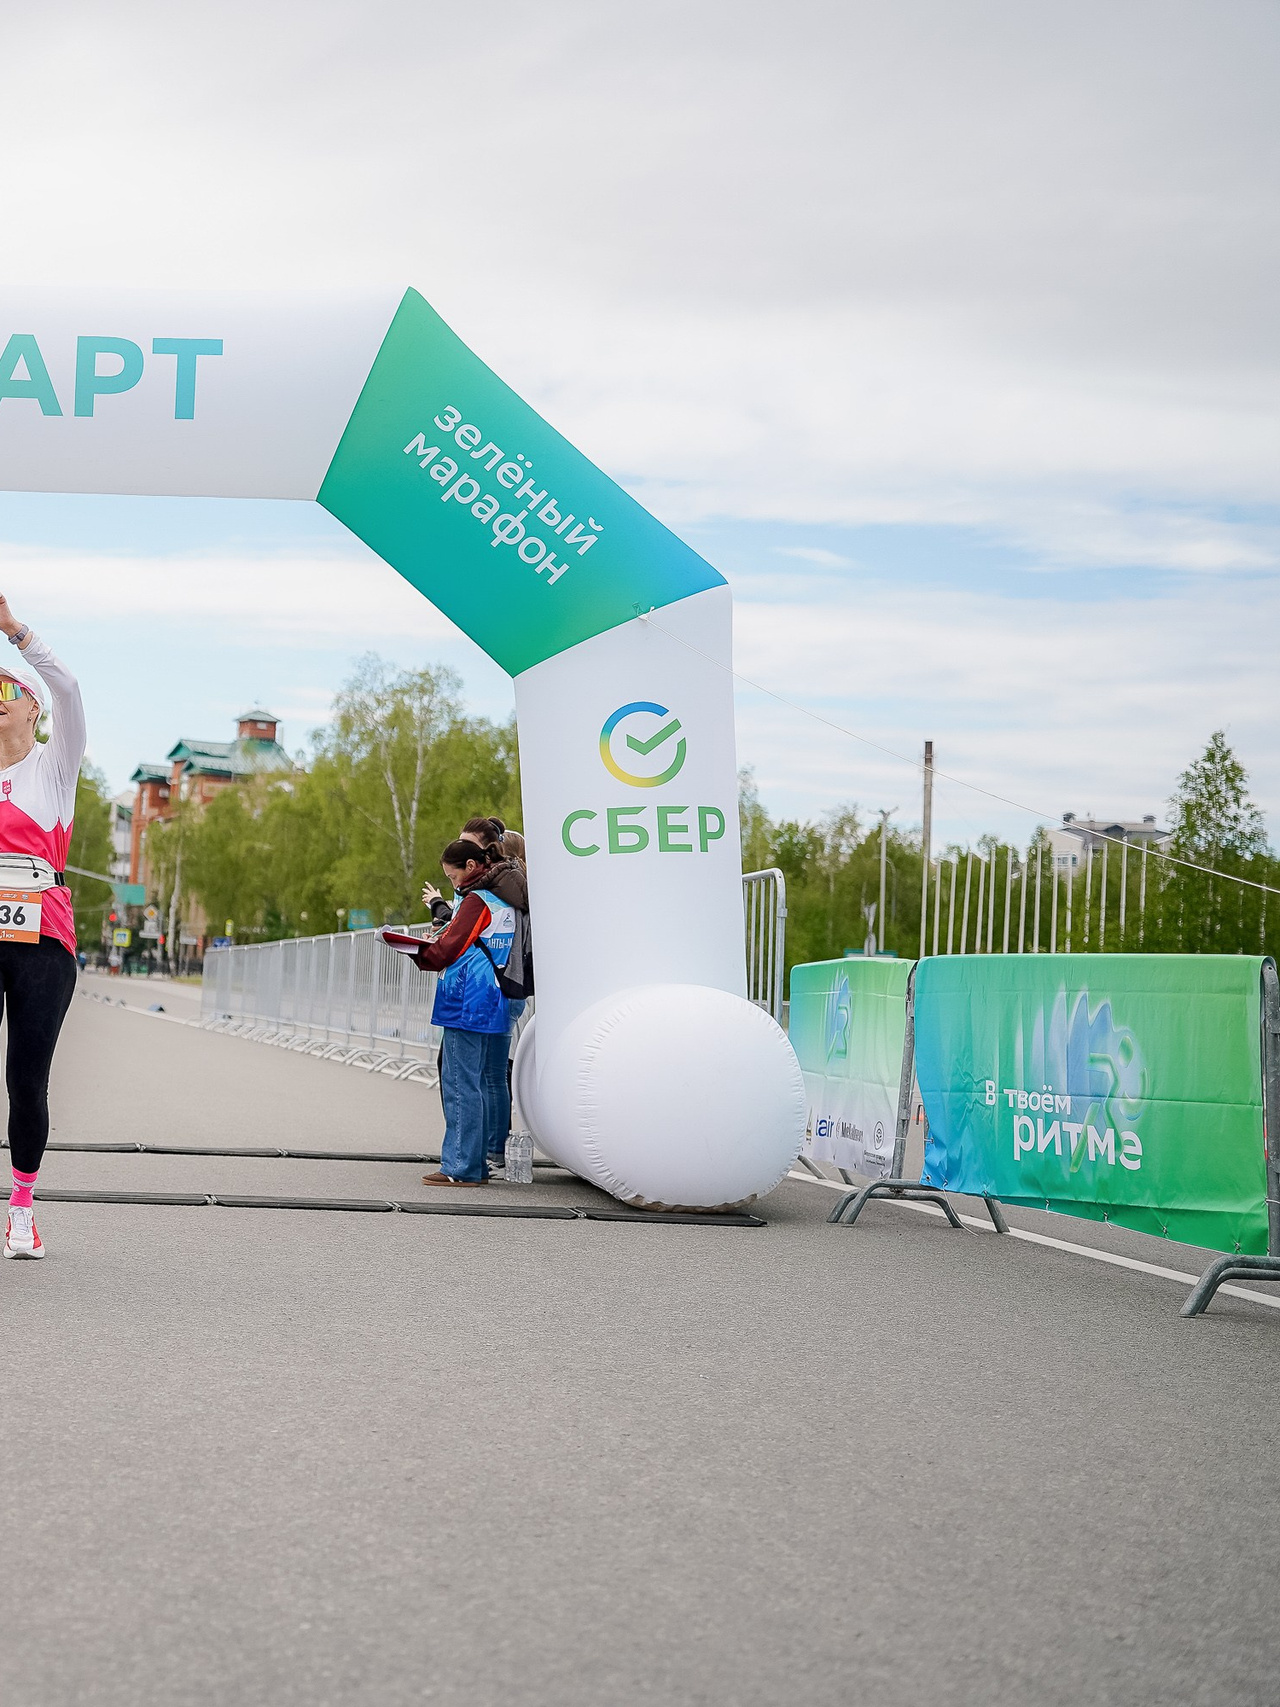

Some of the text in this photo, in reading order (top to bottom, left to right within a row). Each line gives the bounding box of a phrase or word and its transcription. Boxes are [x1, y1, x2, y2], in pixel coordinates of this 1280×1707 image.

[402, 431, 570, 587] марафон
[433, 404, 605, 557] зелёный
[561, 805, 726, 857] СБЕР
[985, 1079, 1071, 1115] В твоём
[1013, 1114, 1143, 1171] ритме
